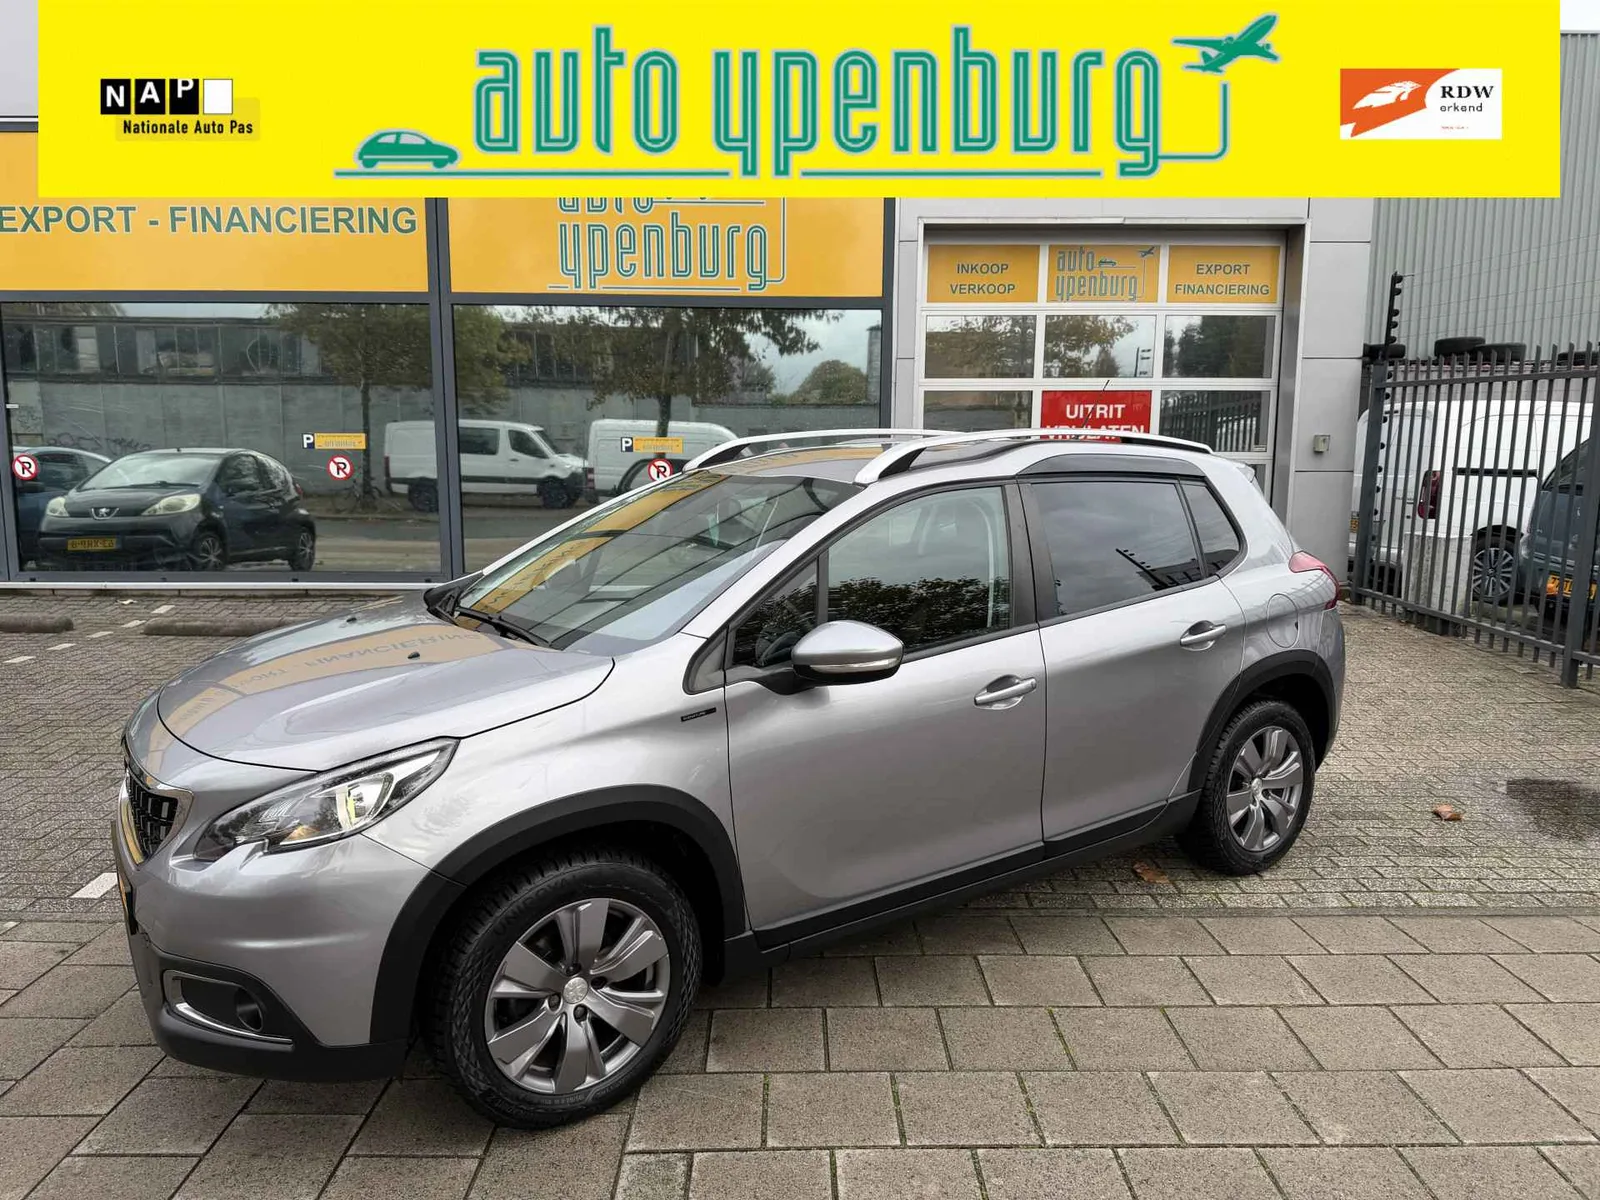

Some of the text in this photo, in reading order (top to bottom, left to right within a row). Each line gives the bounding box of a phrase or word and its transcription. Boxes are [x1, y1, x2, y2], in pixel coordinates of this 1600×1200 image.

[0, 206, 137, 234] EXPORT
[169, 206, 418, 235] FINANCIERING
[558, 211, 768, 292] ypenburg
[1055, 246, 1095, 272] auto
[956, 263, 1010, 275] INKOOP
[1196, 263, 1251, 276] EXPORT
[949, 283, 1016, 295] VERKOOP
[1055, 270, 1138, 302] ypenburg
[1174, 283, 1271, 296] FINANCIERING
[1065, 403, 1127, 419] UITRIT
